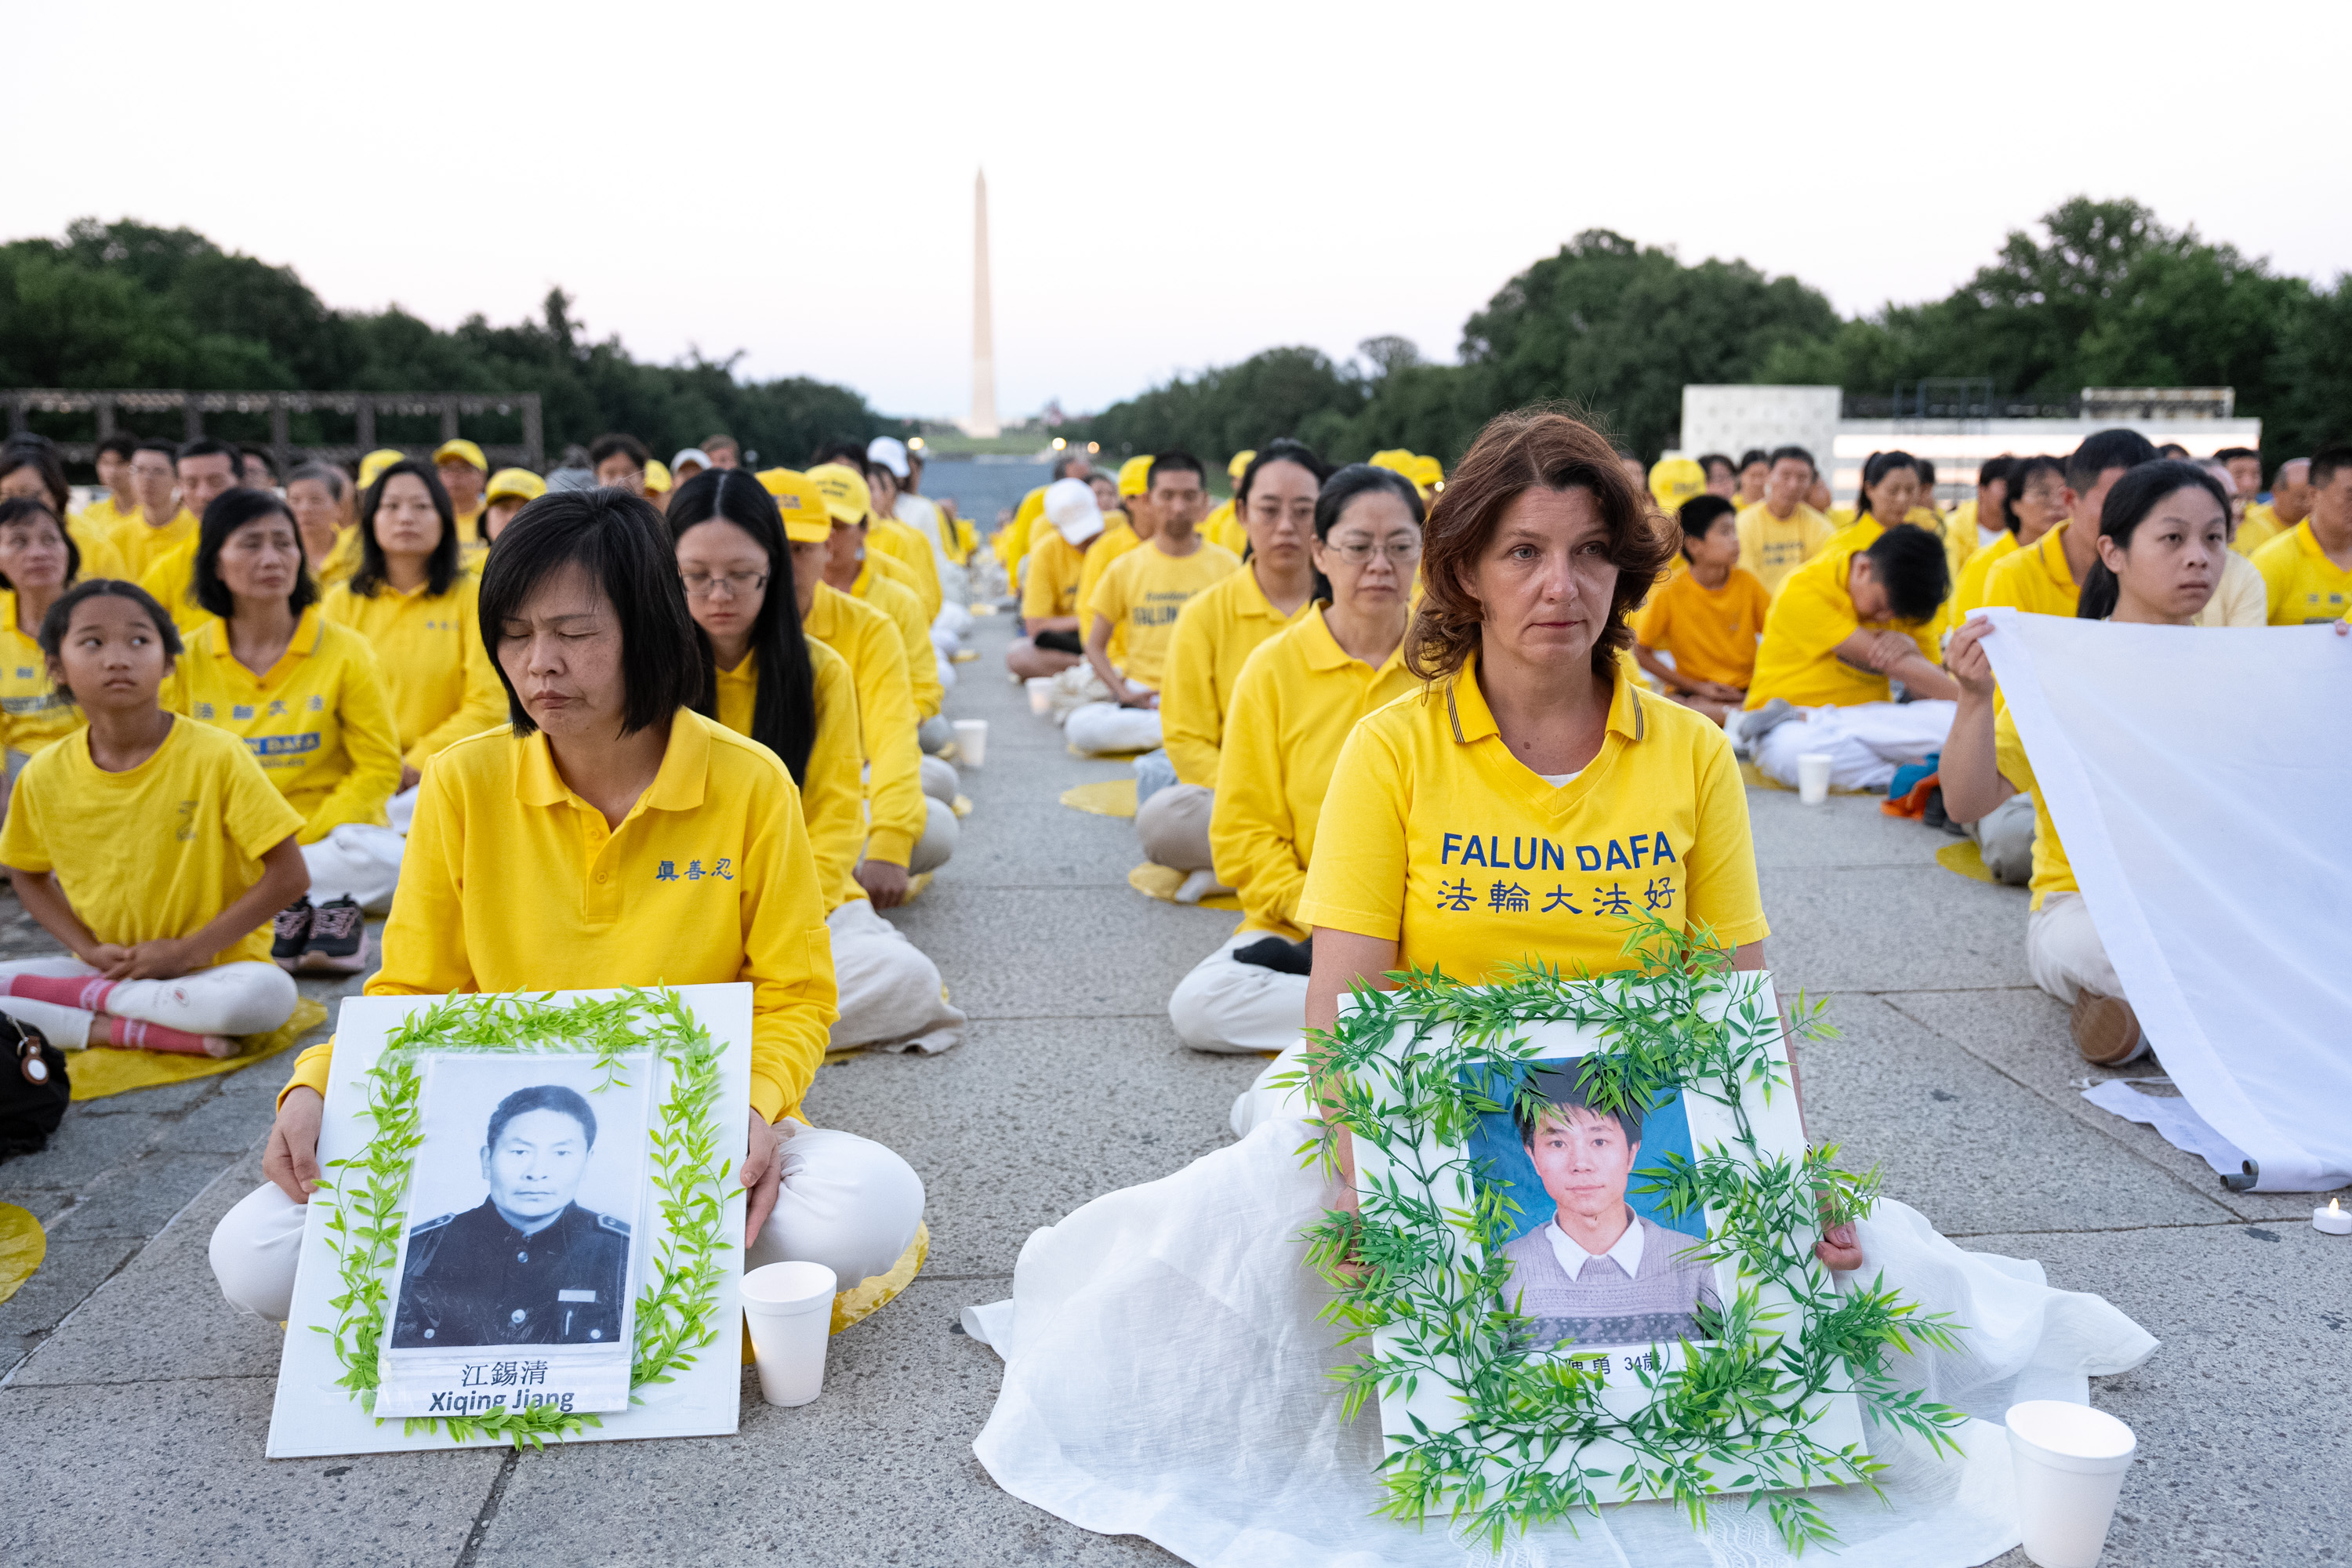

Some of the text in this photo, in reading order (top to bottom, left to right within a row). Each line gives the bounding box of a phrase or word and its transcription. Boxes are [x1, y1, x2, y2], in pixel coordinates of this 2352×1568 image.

[1441, 831, 1676, 872] FALUN DAFA
[1436, 877, 1677, 916] 法輪大法好
[461, 1359, 549, 1388] 江錫清
[428, 1388, 575, 1416] Xiqing Jiang
